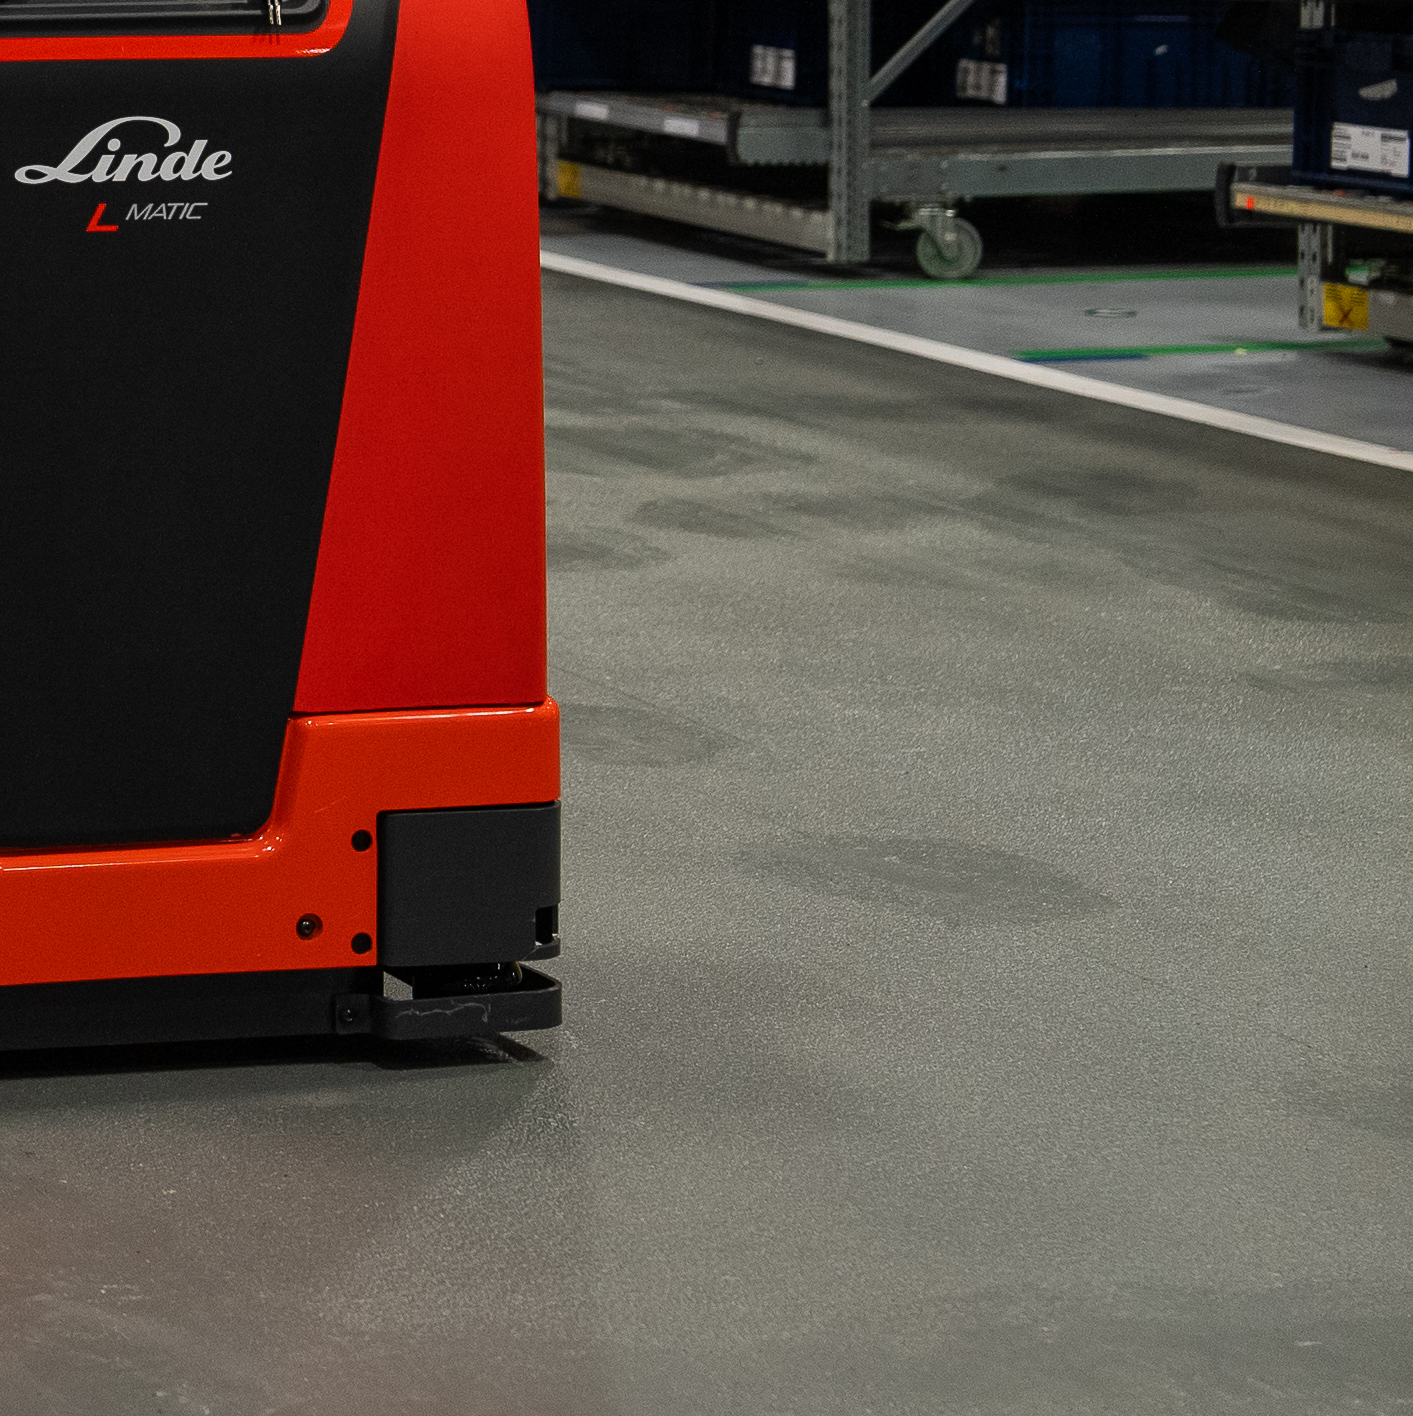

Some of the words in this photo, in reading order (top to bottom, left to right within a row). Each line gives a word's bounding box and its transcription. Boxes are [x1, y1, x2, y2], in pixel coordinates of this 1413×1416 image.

[14, 116, 233, 184] Linde
[86, 203, 118, 232] L
[125, 202, 209, 221] MATIC
